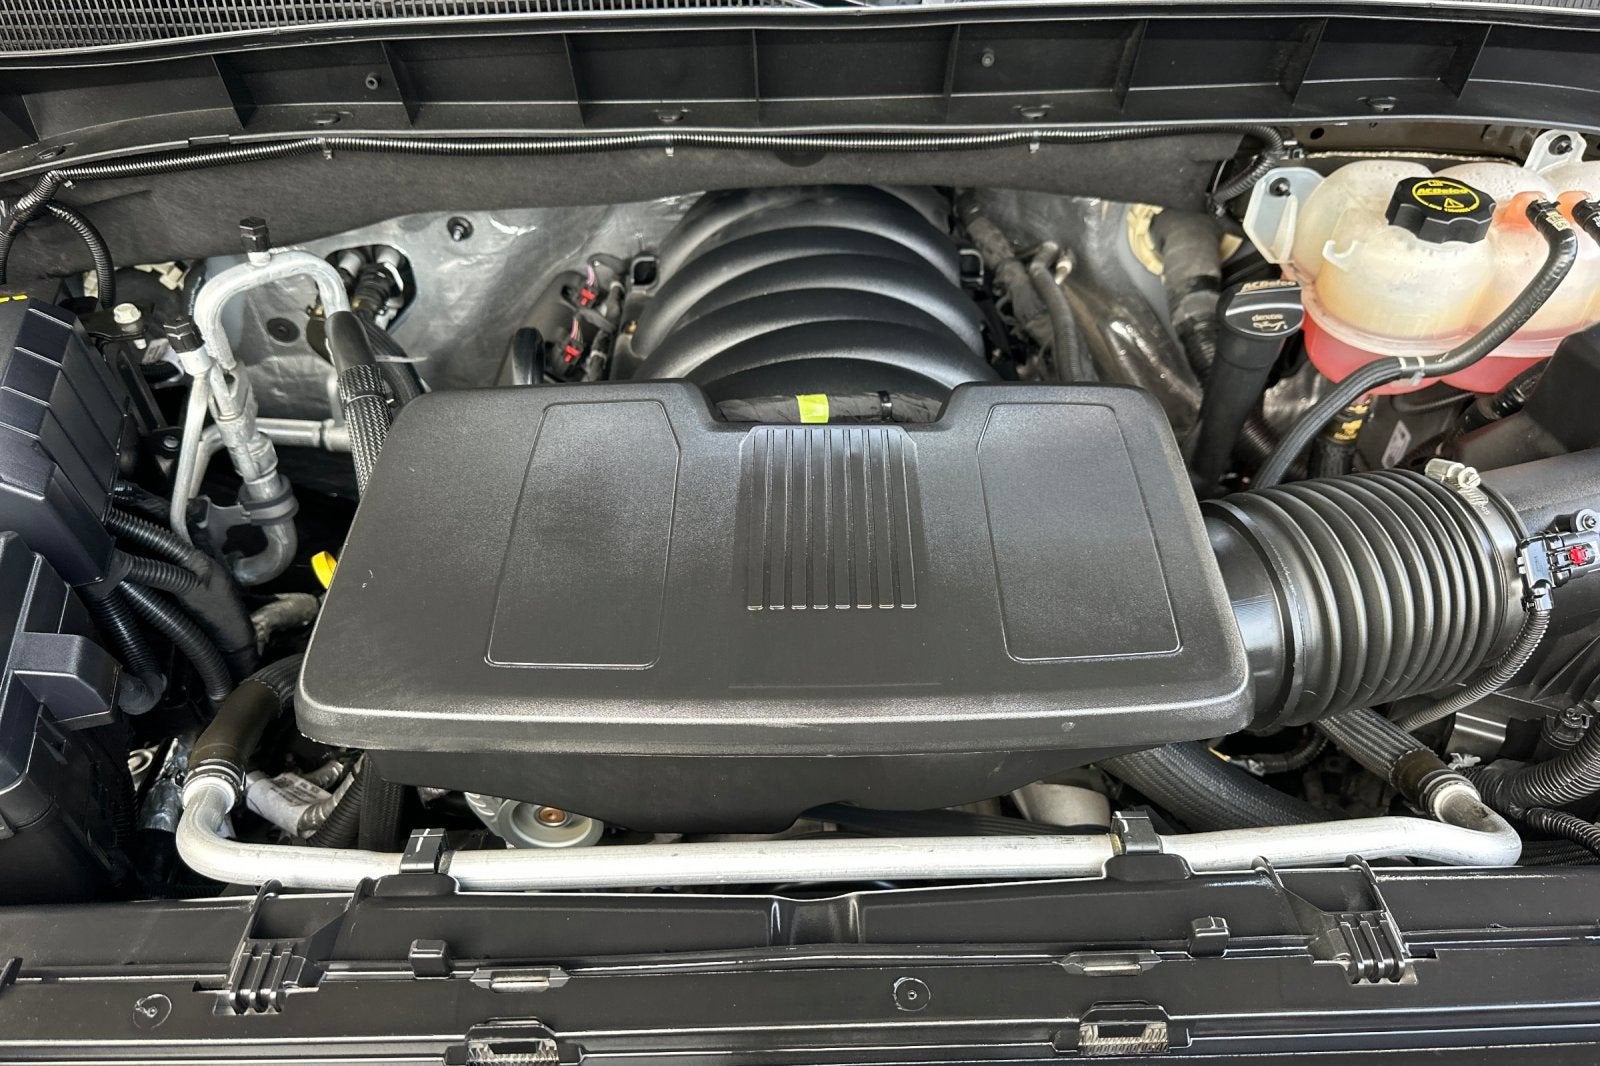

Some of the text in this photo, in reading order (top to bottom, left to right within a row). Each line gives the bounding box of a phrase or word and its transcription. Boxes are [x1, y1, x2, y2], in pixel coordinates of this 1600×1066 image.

[1416, 187, 1468, 195] ACDelco
[1241, 279, 1297, 293] ACDelco
[1251, 313, 1284, 322] dexos
